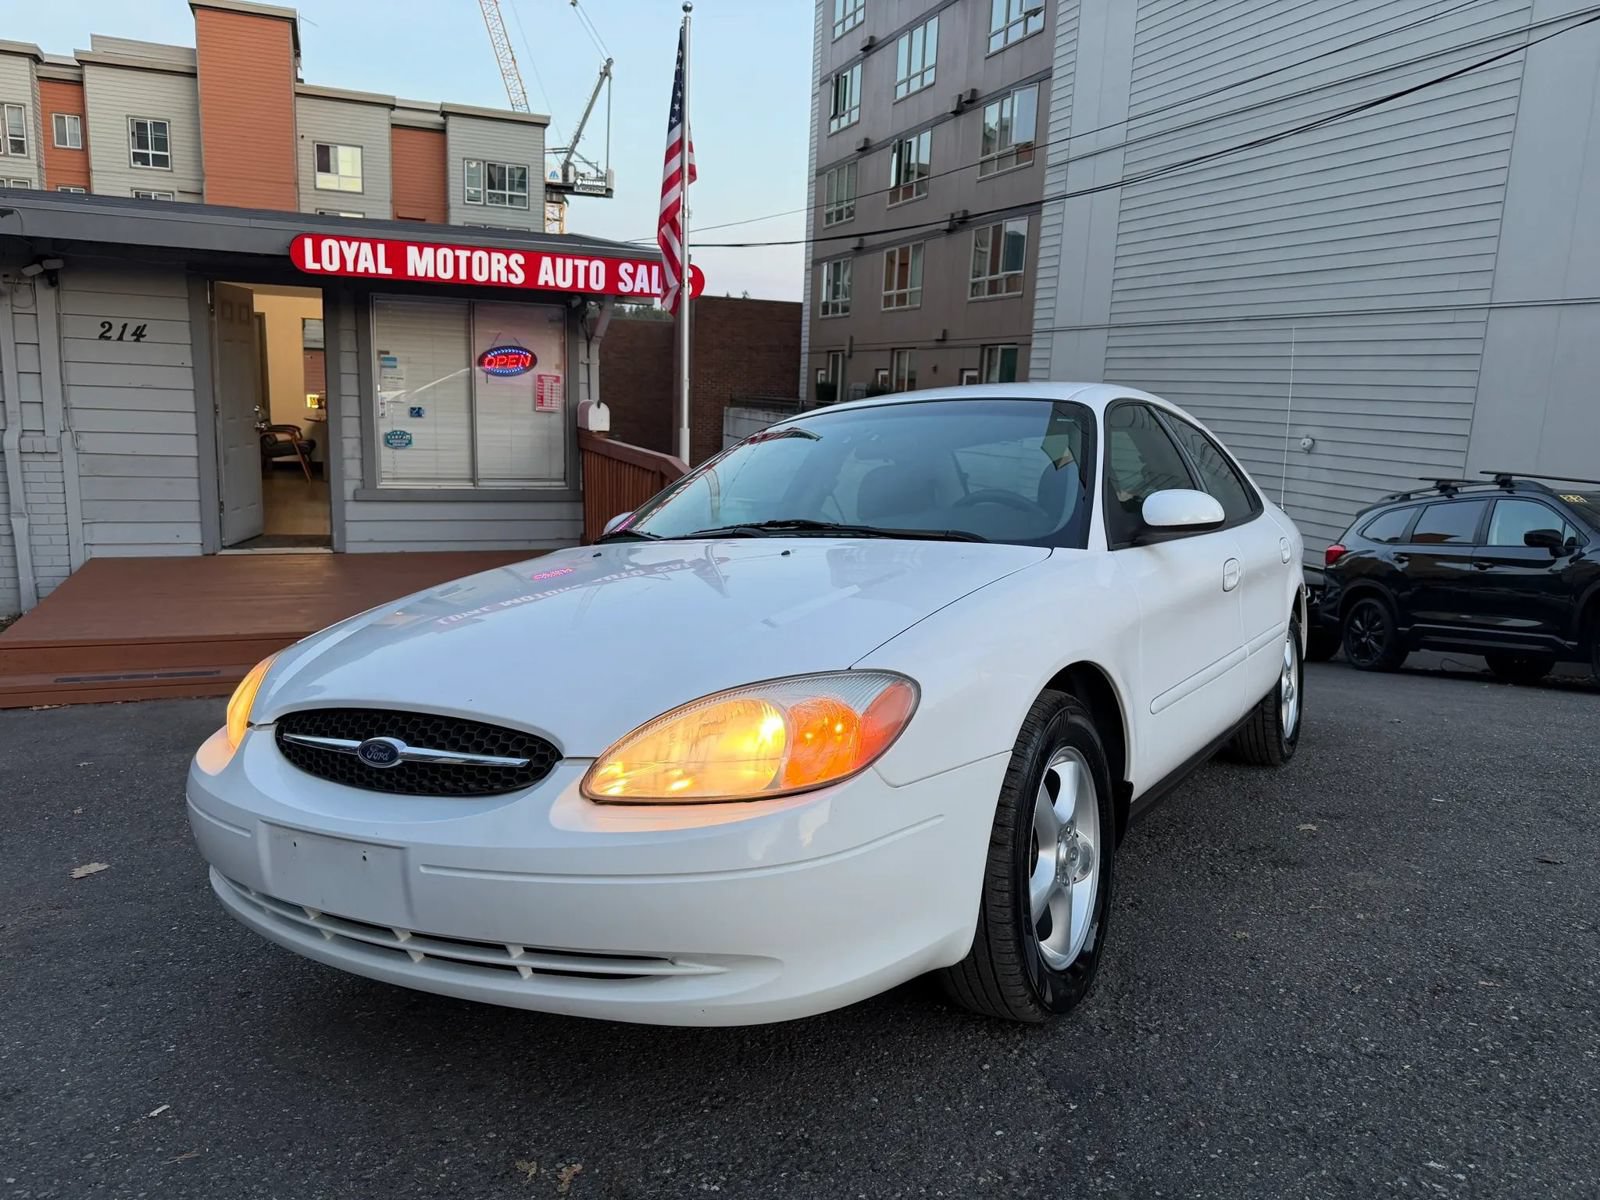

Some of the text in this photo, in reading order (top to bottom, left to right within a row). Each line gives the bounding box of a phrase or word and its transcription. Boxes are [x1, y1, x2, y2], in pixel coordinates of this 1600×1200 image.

[304, 238, 393, 275] LOYAL
[406, 245, 525, 285] MOTORS
[537, 256, 606, 291] AUTO
[99, 321, 147, 342] 214
[485, 354, 531, 369] OPEN
[366, 744, 390, 760] Ford
